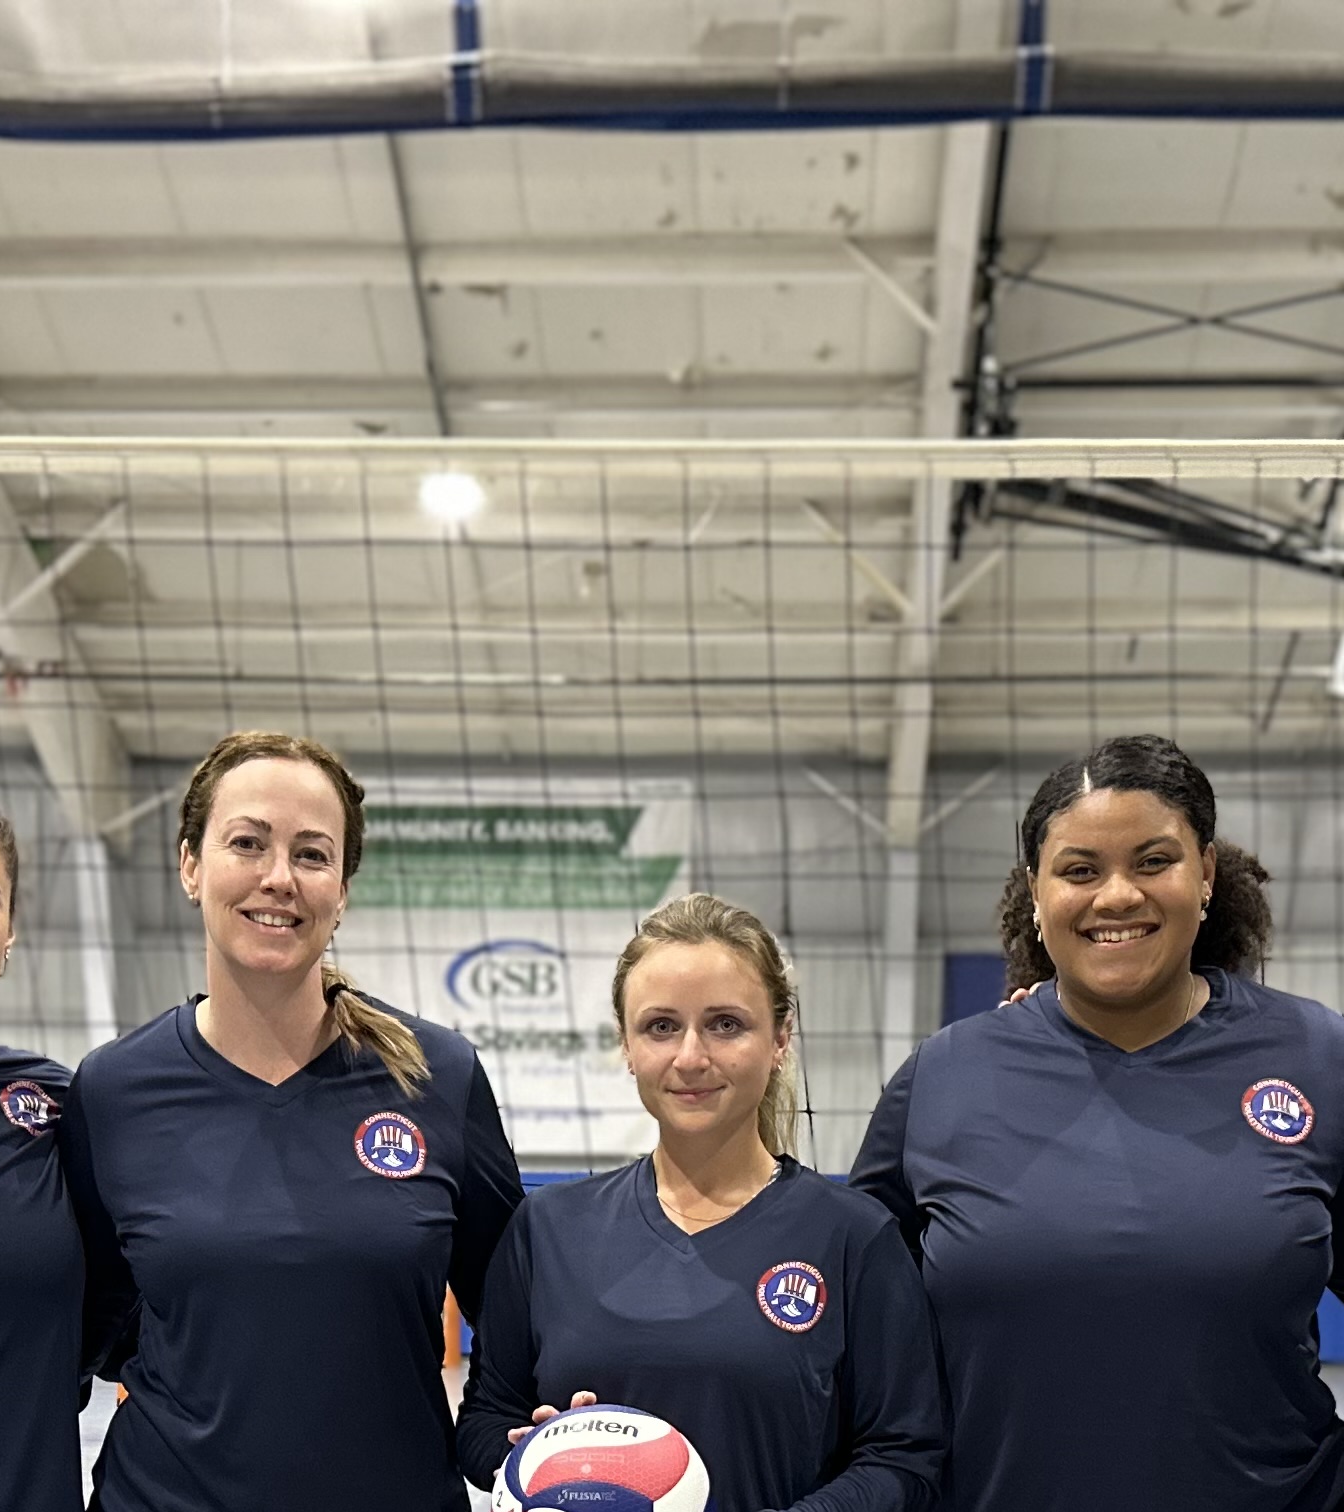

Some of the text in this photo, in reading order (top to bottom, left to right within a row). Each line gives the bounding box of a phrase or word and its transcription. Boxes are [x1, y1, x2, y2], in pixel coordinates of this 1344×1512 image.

[470, 959, 558, 999] GSB
[1252, 1079, 1304, 1100] CONNECTICUT
[364, 1112, 418, 1131] CONNECTICUT
[1244, 1101, 1273, 1140] VOLLEYBALL
[355, 1139, 386, 1175] VOLLEYBALL
[771, 1261, 824, 1283] CONNECTICUT
[758, 1283, 781, 1327] VOLLEYBALL
[544, 1419, 639, 1439] molten
